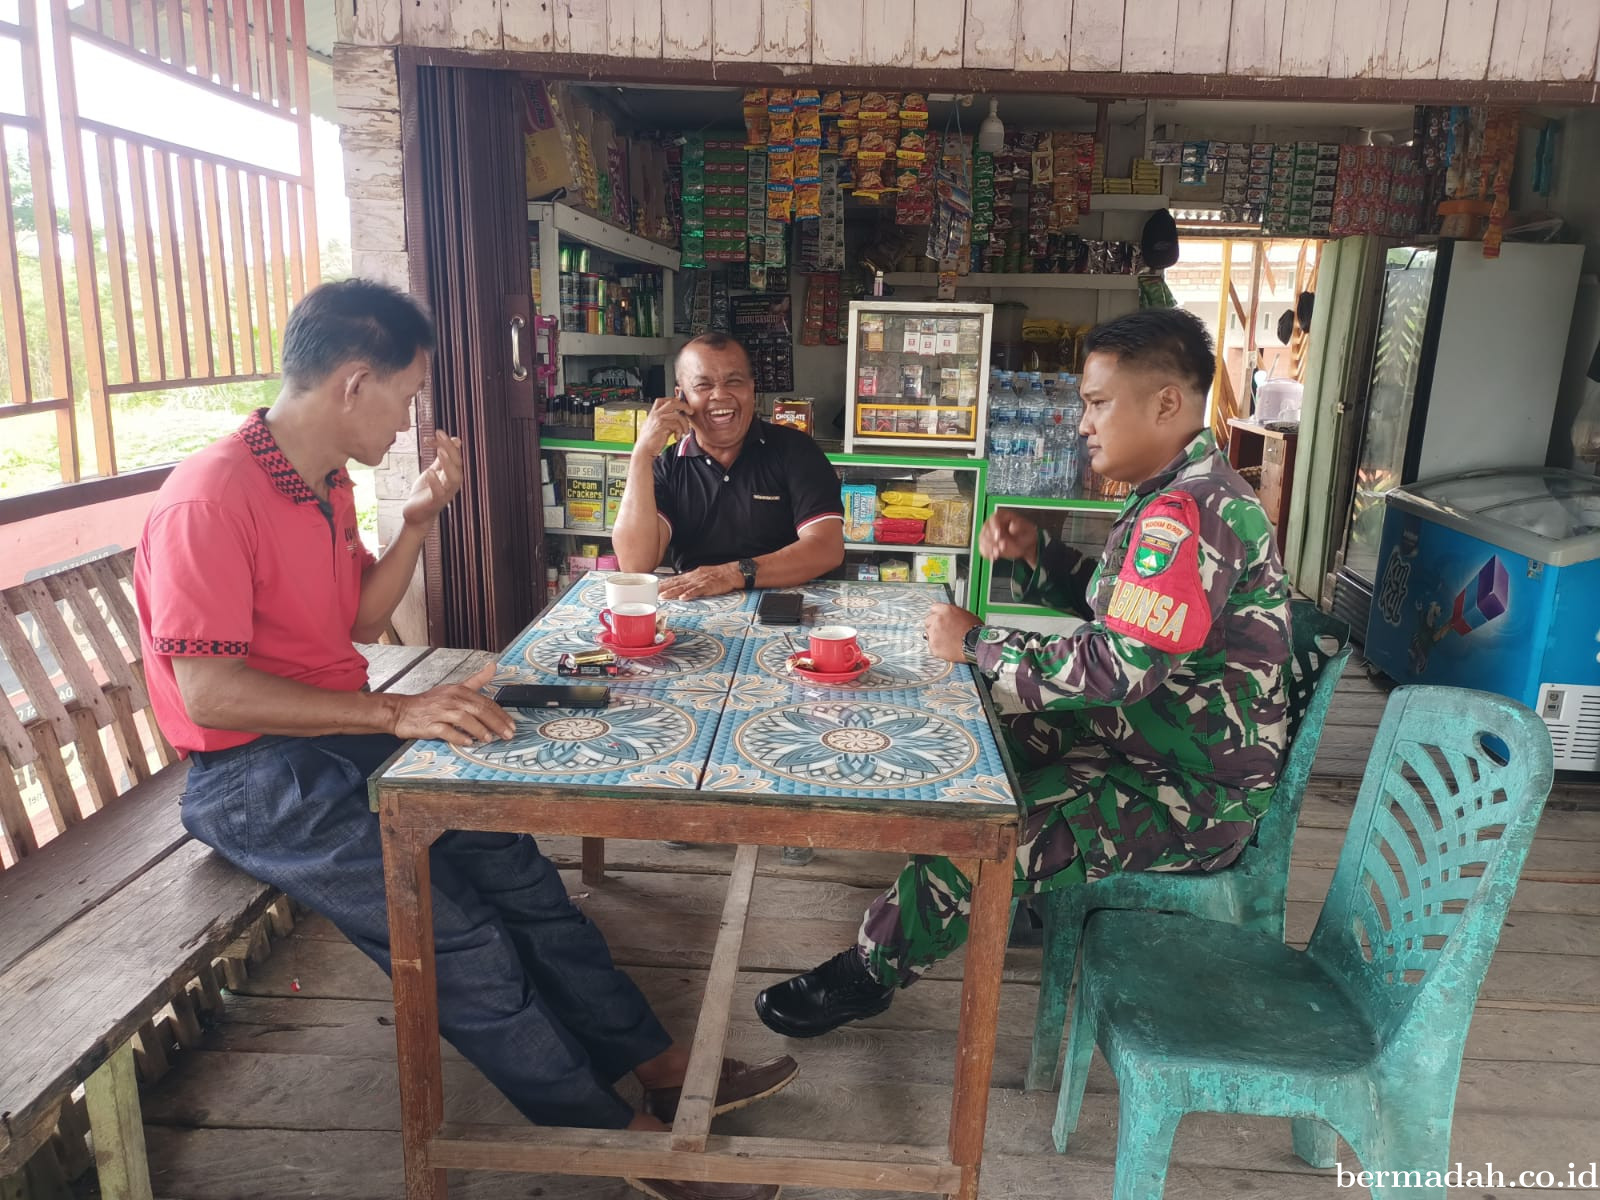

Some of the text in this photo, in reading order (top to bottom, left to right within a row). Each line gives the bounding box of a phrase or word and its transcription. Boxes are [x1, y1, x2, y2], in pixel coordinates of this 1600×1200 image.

[572, 480, 597, 490] Cream
[567, 488, 603, 499] Crackers
[1145, 520, 1166, 529] KODIM
